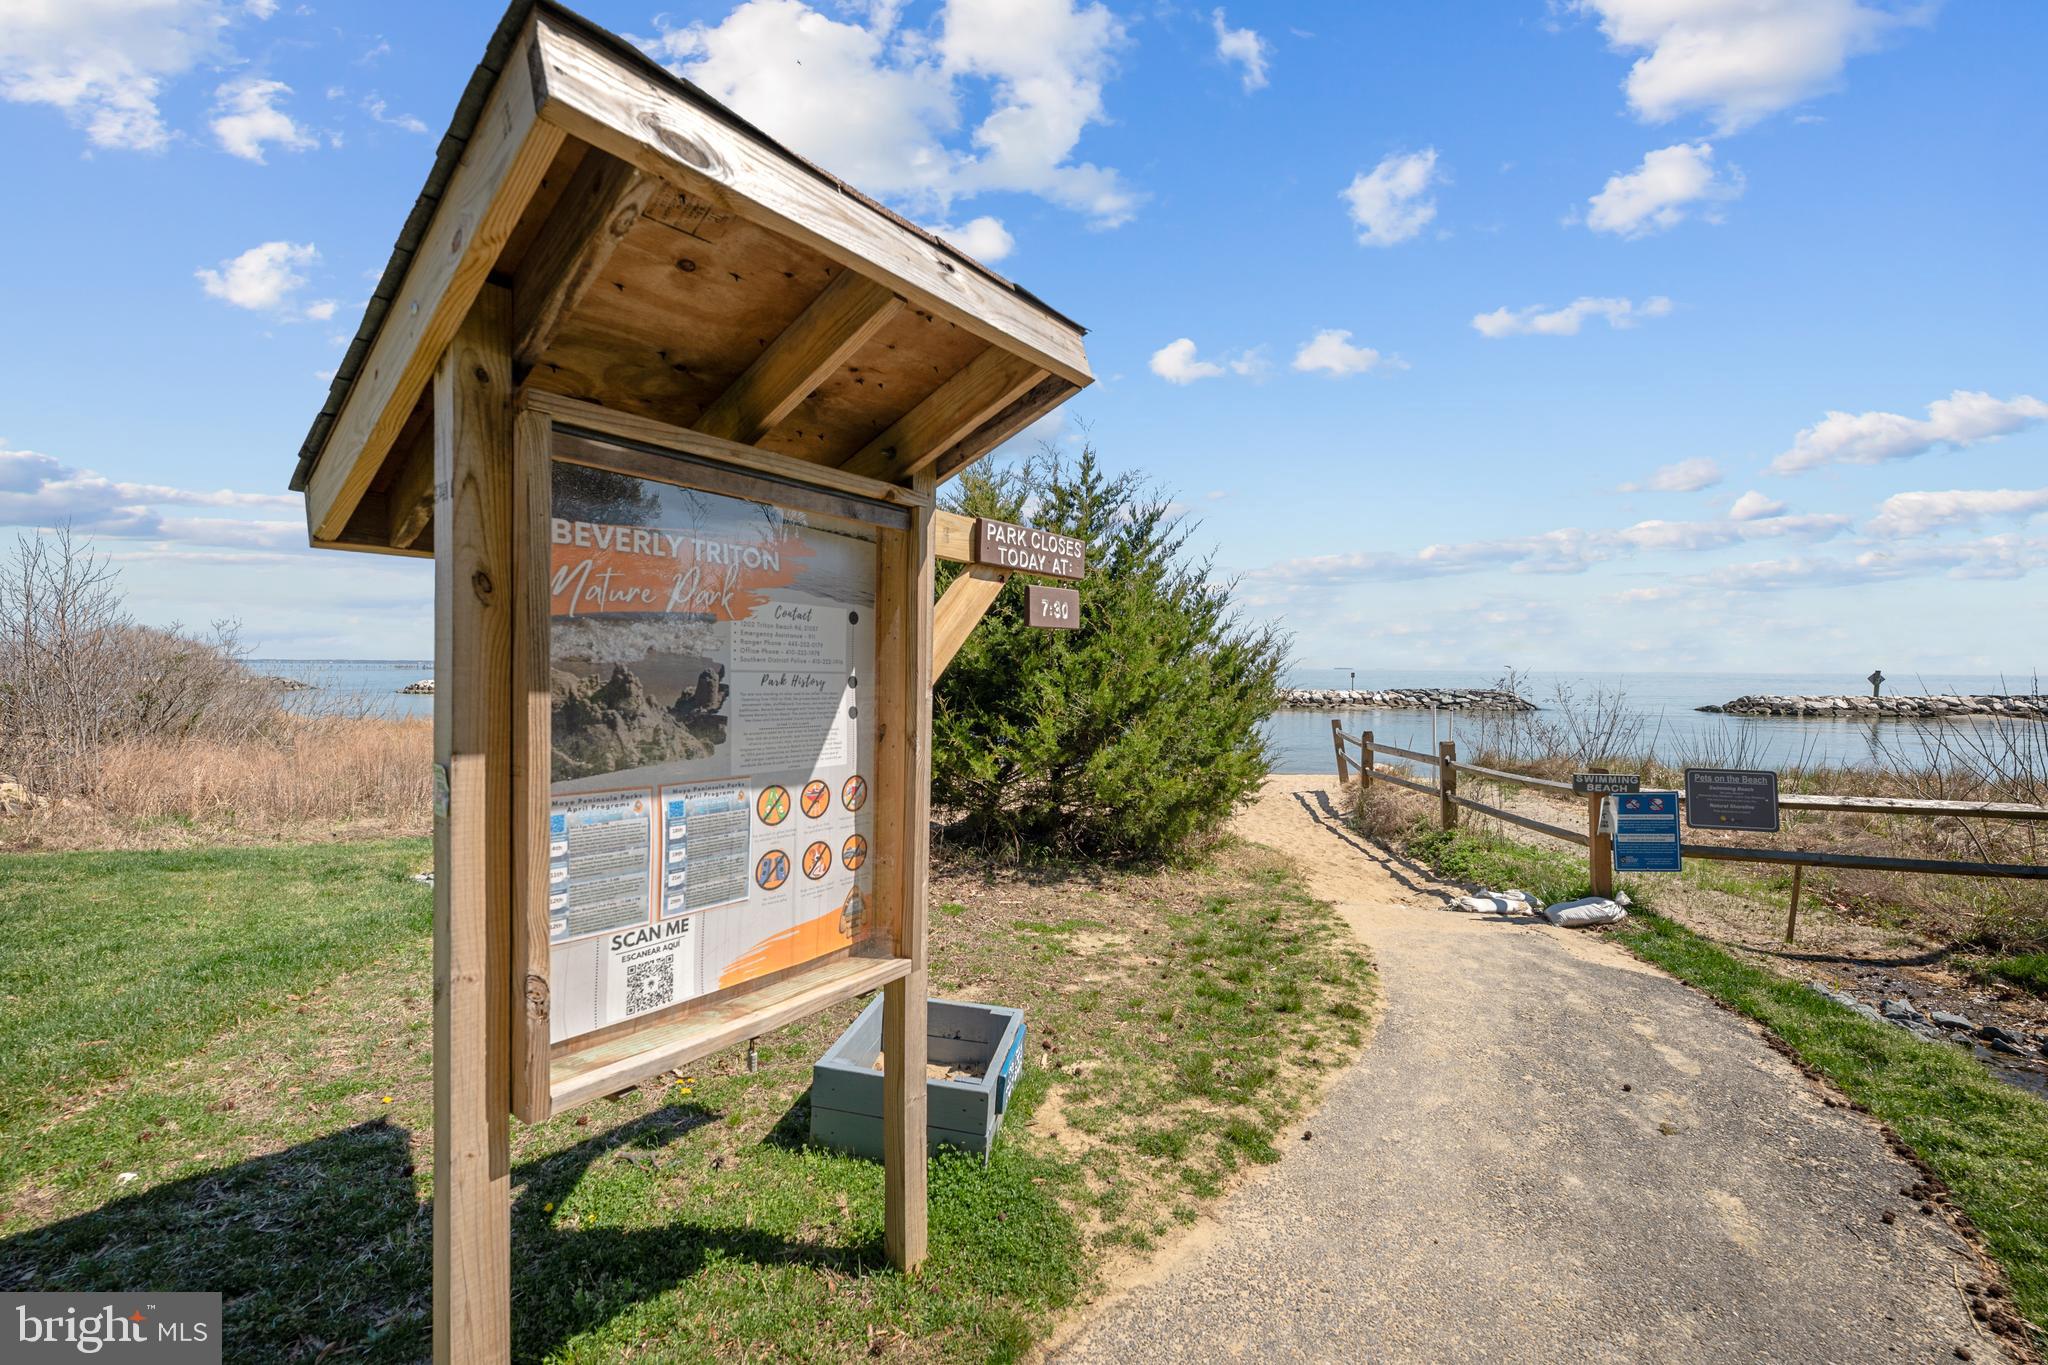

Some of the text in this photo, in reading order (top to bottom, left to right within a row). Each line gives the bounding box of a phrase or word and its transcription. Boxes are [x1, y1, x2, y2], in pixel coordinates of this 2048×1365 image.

[550, 517, 781, 572] BEVERLY TRITON
[987, 523, 1082, 559] PARK CLOSES
[997, 546, 1073, 576] TODAY AT:
[551, 559, 740, 620] Nature Park
[774, 604, 813, 622] Contact
[1041, 599, 1069, 620] 7:30
[740, 629, 773, 639] Emergency
[740, 647, 760, 655] Office
[761, 648, 780, 656] Phone
[760, 673, 827, 692] Park History
[1575, 775, 1639, 785] SWIMMING
[1694, 773, 1768, 785] Pets on the Beach
[685, 790, 735, 801] April Programs
[693, 784, 725, 792] Peninsula
[1586, 783, 1628, 793] BEACH
[552, 800, 575, 808] Mayo
[578, 796, 618, 805] Peninsula
[566, 801, 630, 813] April Programs
[611, 917, 690, 951] SCAN ME
[621, 938, 681, 964] ESCANEAR AQUÍ
